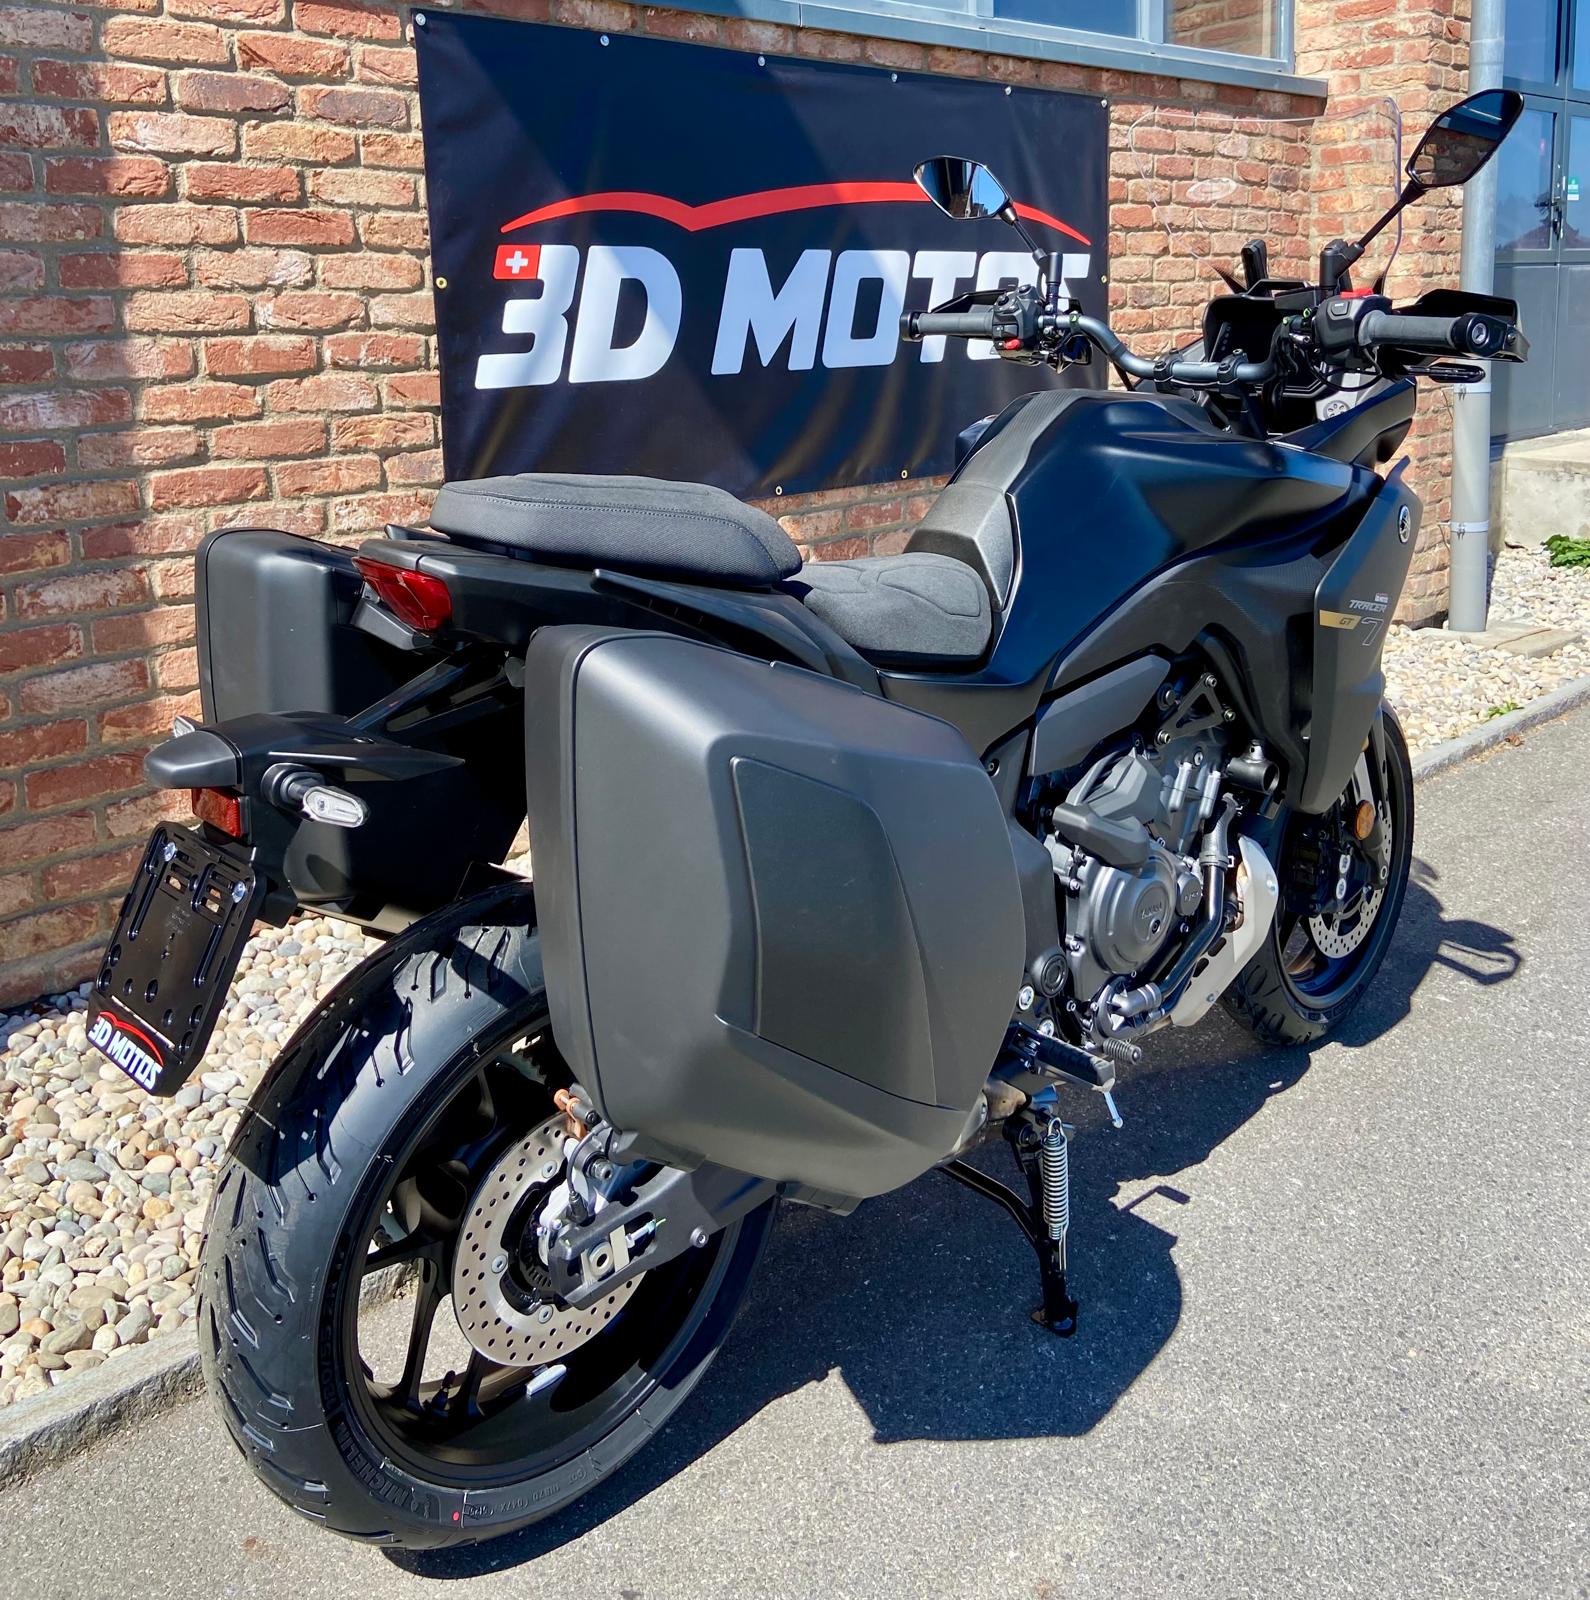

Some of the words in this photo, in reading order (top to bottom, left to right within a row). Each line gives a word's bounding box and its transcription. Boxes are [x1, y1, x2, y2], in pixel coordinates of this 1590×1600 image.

[475, 244, 683, 390] 3D
[1340, 617, 1354, 626] GT
[1349, 600, 1387, 612] TRACER
[1361, 616, 1384, 646] 7
[87, 1016, 113, 1048] 3D
[106, 1030, 163, 1090] MOTOS
[334, 1421, 410, 1505] MICHELIN
